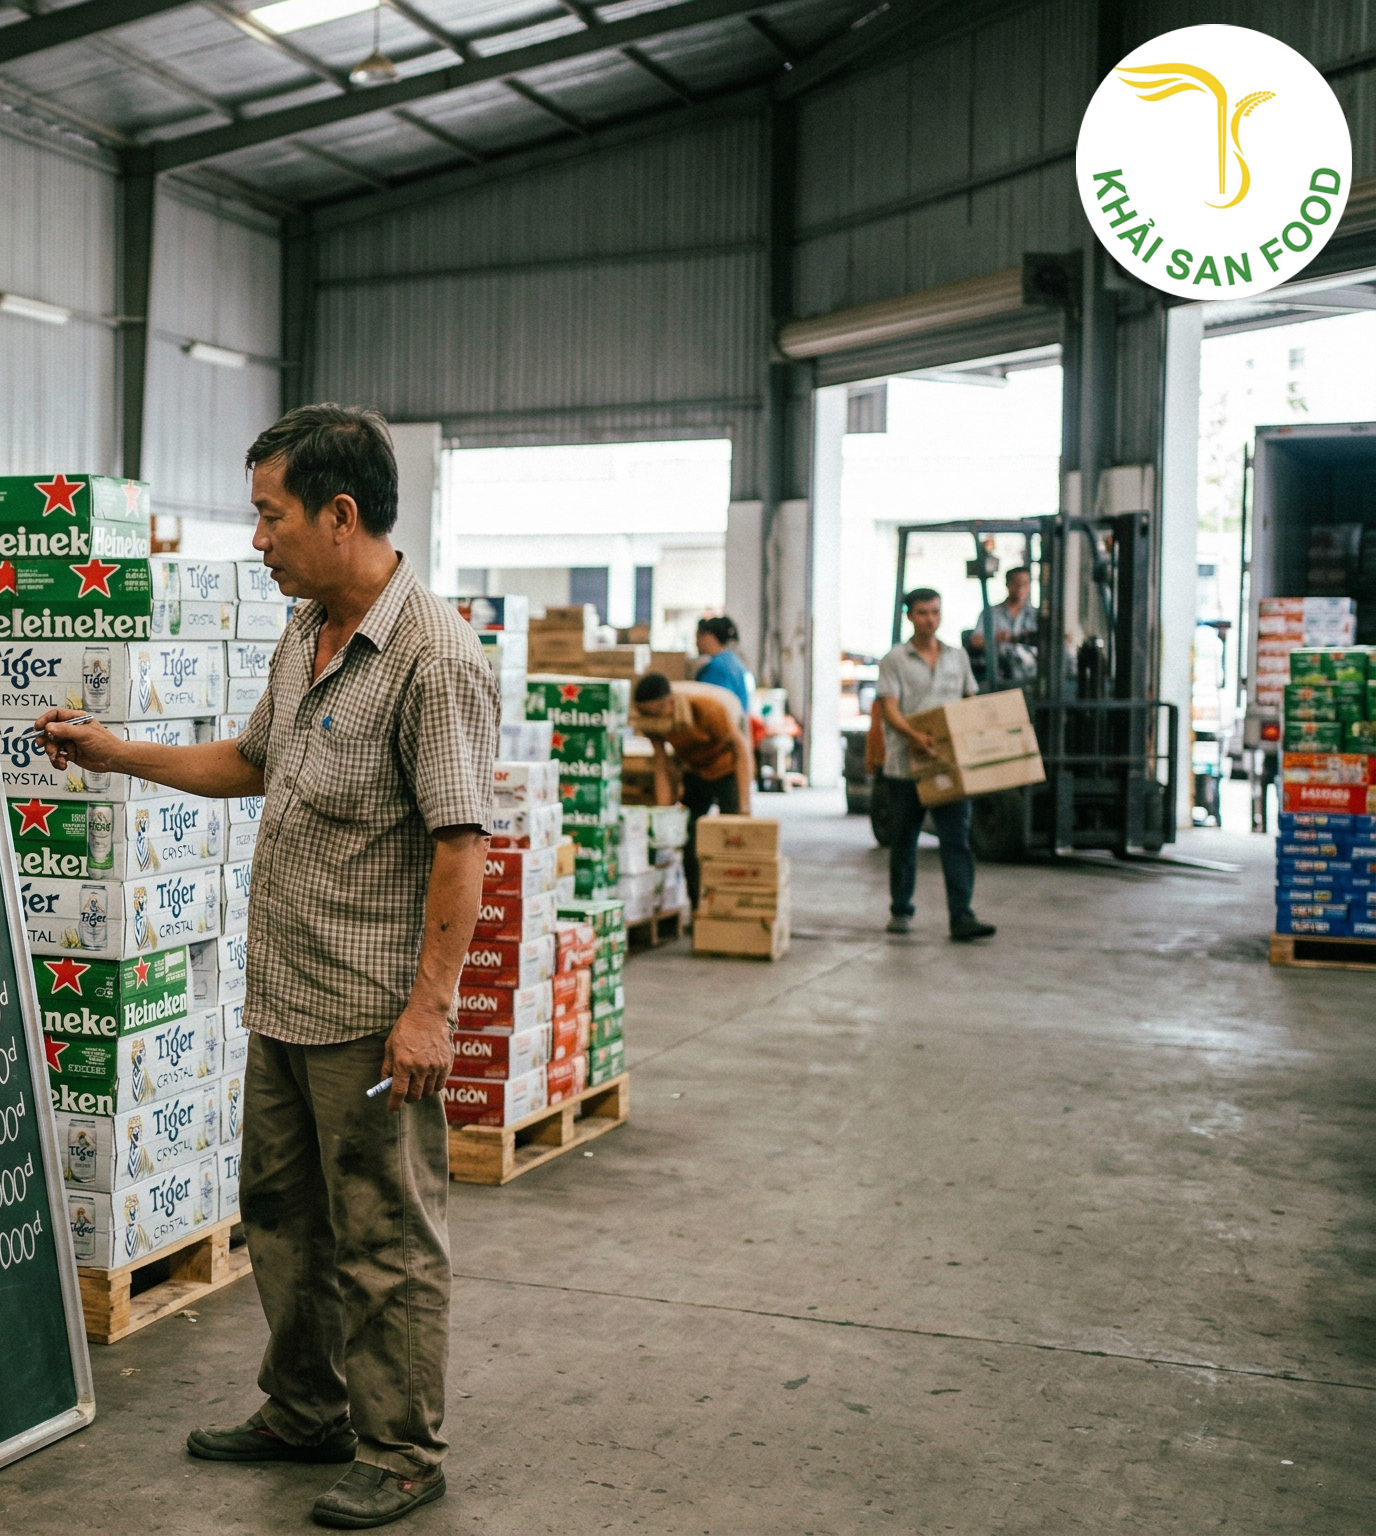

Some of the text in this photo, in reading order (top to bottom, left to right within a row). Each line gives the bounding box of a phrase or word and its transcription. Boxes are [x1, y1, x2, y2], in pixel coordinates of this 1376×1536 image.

[159, 802, 199, 842] Tiger
[123, 990, 187, 1031] Heineken
[155, 1025, 195, 1066] Tiger
